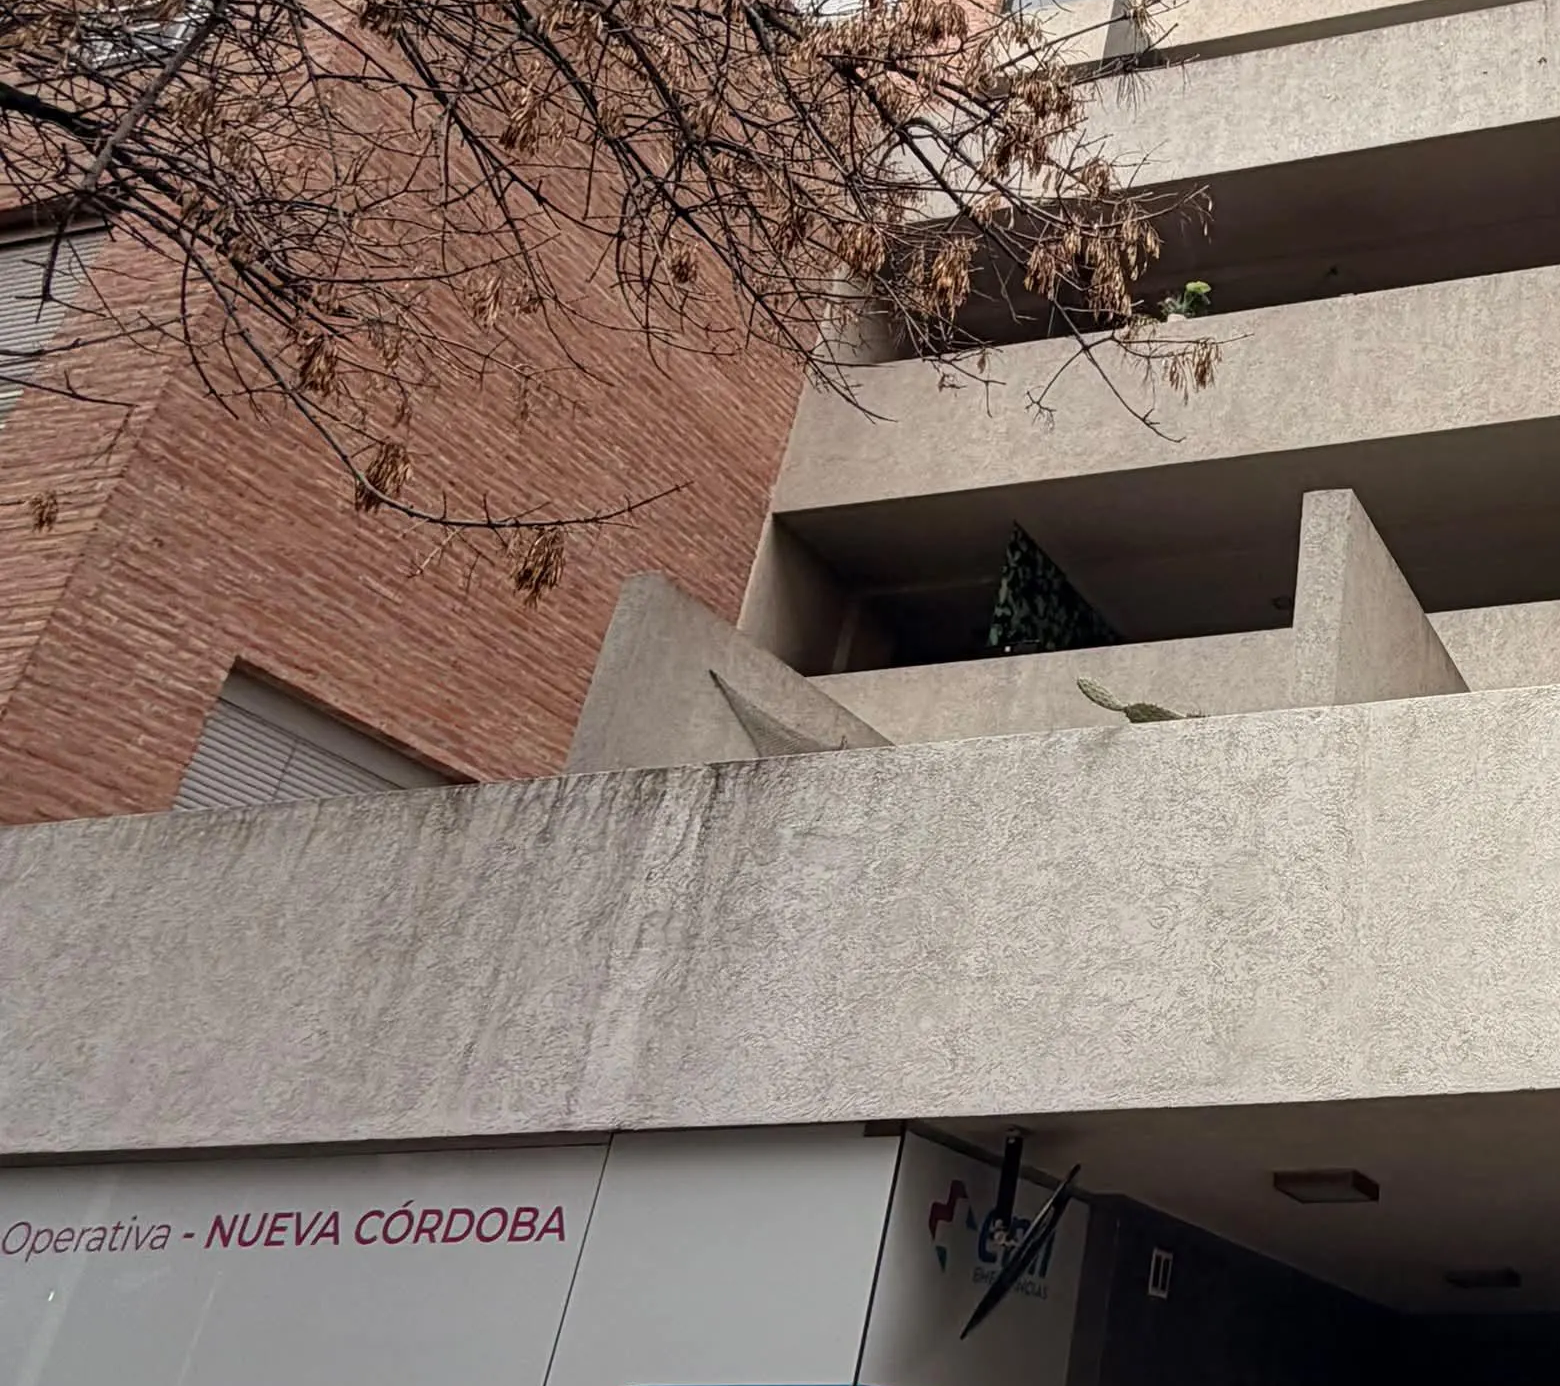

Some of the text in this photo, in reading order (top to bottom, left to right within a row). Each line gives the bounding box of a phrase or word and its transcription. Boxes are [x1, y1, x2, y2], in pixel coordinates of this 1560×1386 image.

[1, 1215, 173, 1262] Operativa
[204, 1210, 341, 1249] NUEVA
[354, 1200, 567, 1245] CÓRDOBA
